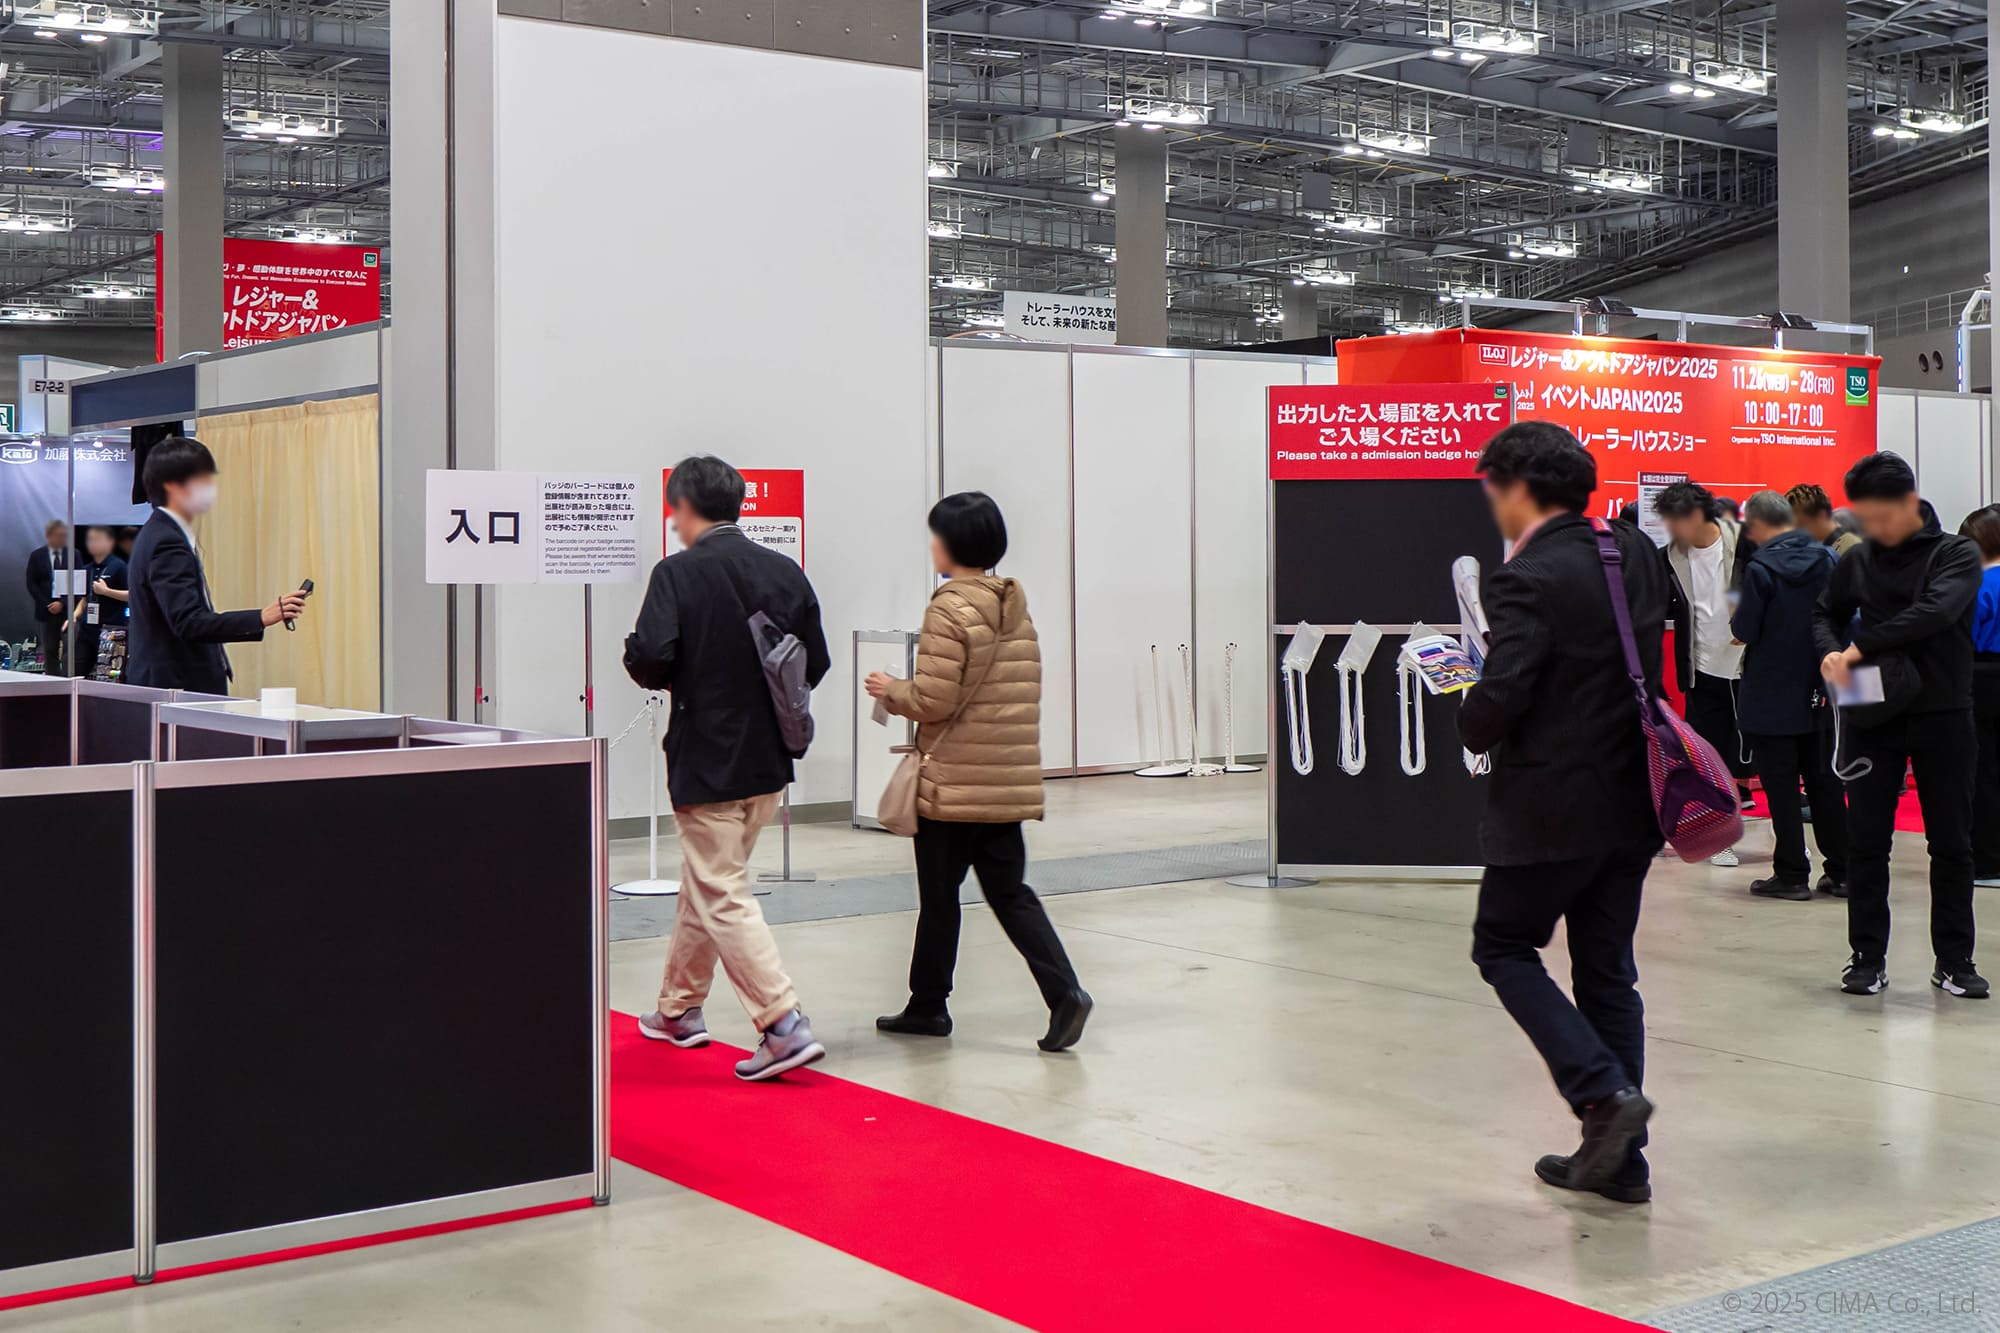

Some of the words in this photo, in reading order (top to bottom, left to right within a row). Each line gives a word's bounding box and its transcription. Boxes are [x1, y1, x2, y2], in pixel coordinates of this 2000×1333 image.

[232, 285, 319, 310] レジャー&
[35, 381, 64, 393] E7-2-2
[1850, 375, 1866, 387] TSO
[1517, 401, 1535, 411] 2025
[1541, 383, 1683, 414] イベントJAPAN2025
[1277, 403, 1502, 424] 出力した入場証を入れて
[1319, 426, 1461, 447] ご入場ください
[1566, 425, 1707, 452] レーラーハウスショー
[1760, 433, 1776, 444] TSO
[1777, 434, 1821, 446] International
[1822, 436, 1837, 446] Inc.
[1277, 451, 1318, 460] Please
[1320, 451, 1347, 460] take
[1361, 450, 1421, 460] admission
[1424, 450, 1462, 460] badge
[741, 502, 757, 511] ON
[445, 509, 520, 545] 入口
